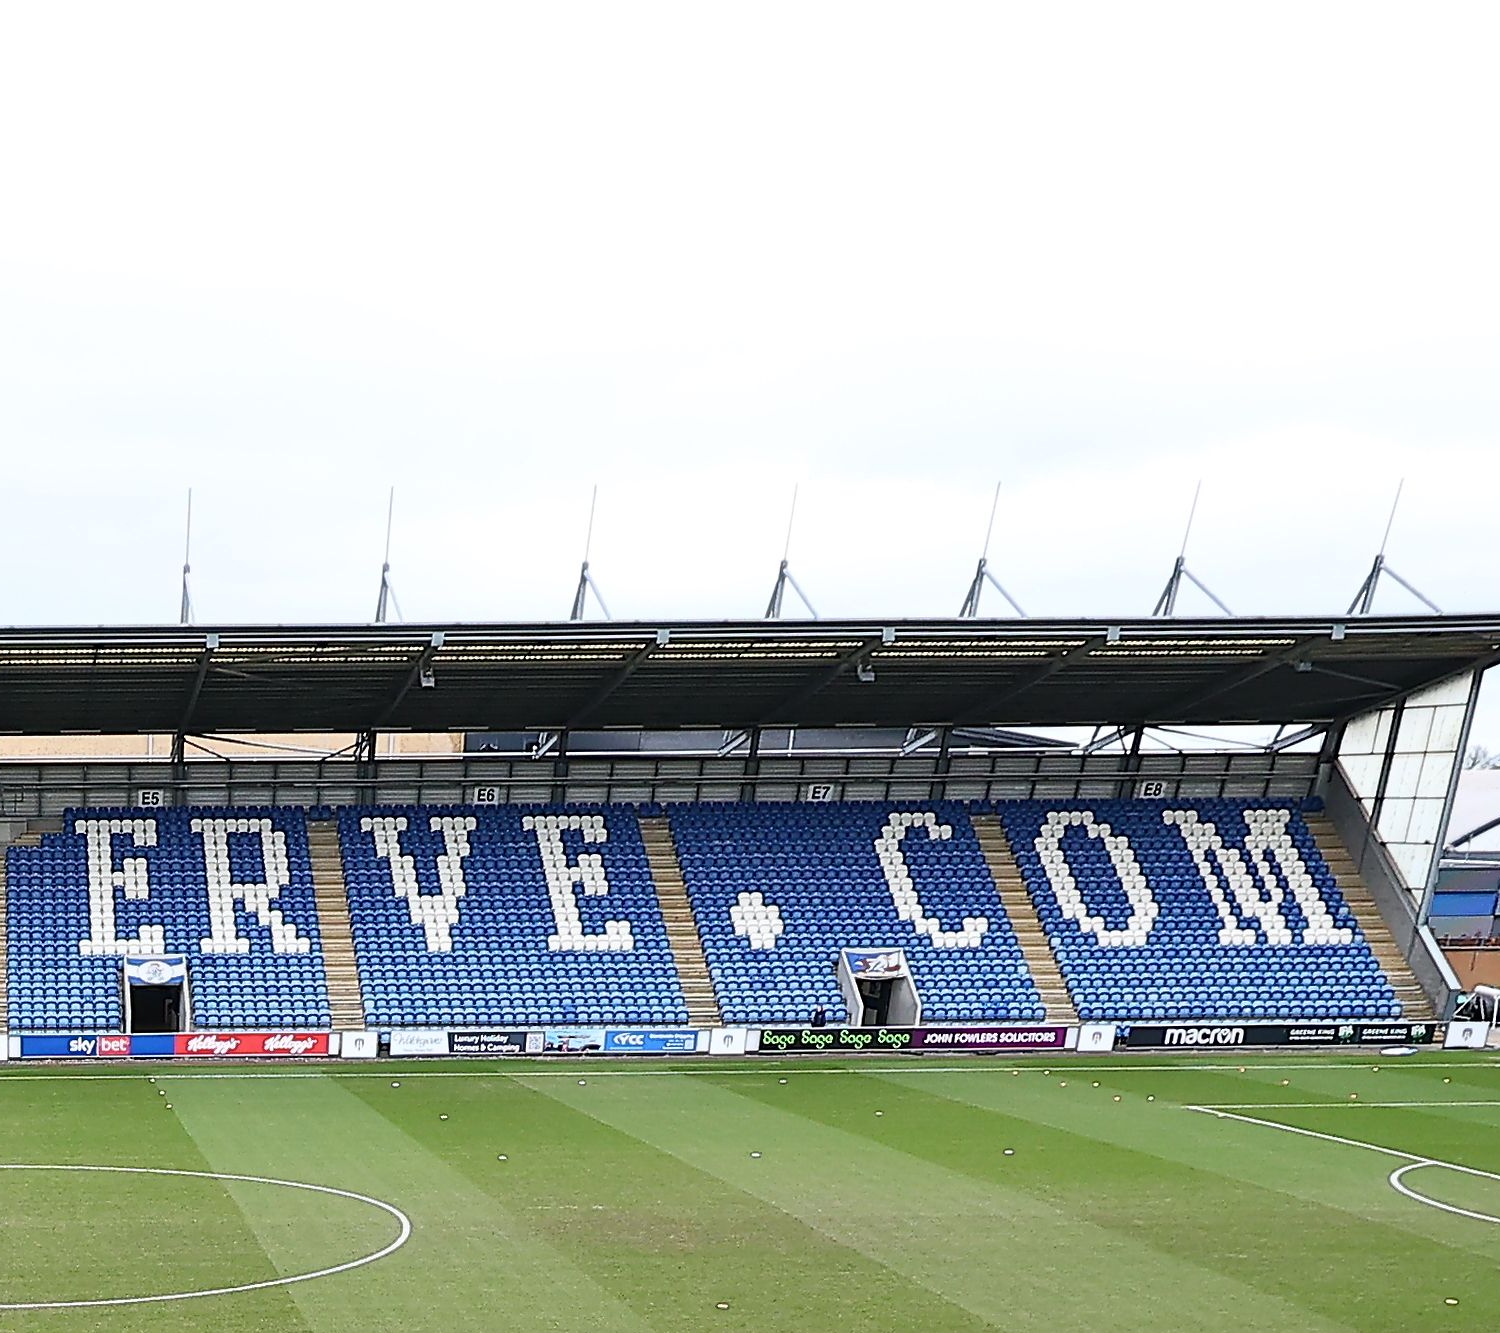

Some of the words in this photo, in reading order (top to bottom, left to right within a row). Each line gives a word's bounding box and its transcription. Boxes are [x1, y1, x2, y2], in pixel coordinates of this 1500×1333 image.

[476, 787, 495, 803] E6
[811, 785, 831, 801] E7
[1143, 782, 1162, 797] E8
[141, 790, 160, 805] E5
[923, 1032, 952, 1045] JOHN
[953, 1031, 998, 1044] FOWLERS
[999, 1031, 1056, 1043] SOLICITORS
[1164, 1025, 1245, 1045] macron
[1289, 1028, 1315, 1036] GREENE
[1361, 1027, 1387, 1035] GREENE
[1387, 1026, 1407, 1034] KING
[69, 1035, 96, 1054] sky
[100, 1035, 130, 1052] bet
[186, 1034, 241, 1055] Kellogg's
[263, 1033, 317, 1053] Kellogg's
[453, 1034, 480, 1044] Luxury
[480, 1034, 509, 1044] Holiday
[762, 1030, 796, 1050] Sage
[801, 1030, 834, 1049] Sage
[839, 1030, 872, 1049] Sage
[877, 1029, 911, 1049] Sage
[453, 1043, 480, 1052] Homes
[487, 1043, 520, 1053] Camping
